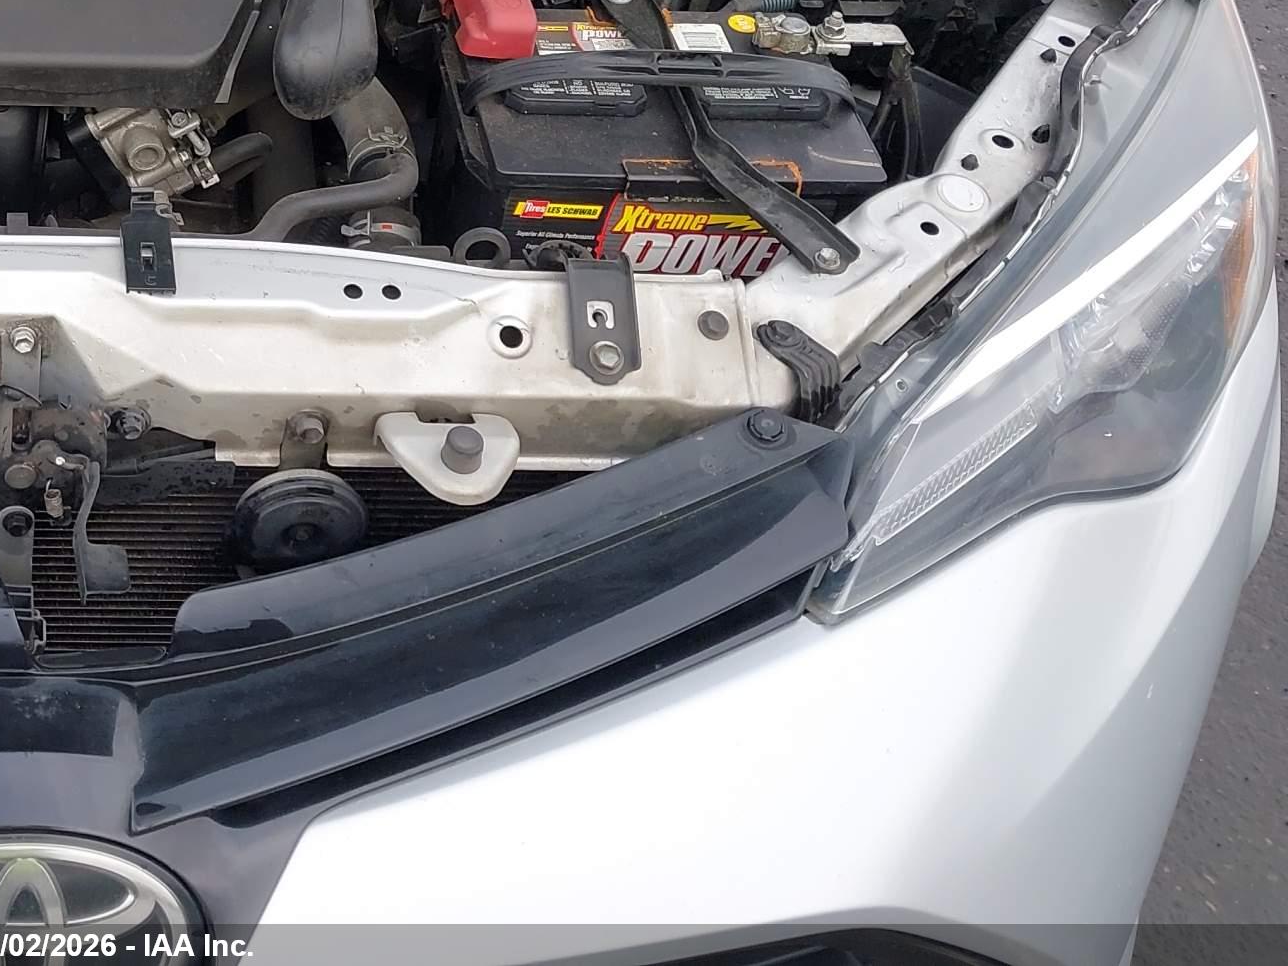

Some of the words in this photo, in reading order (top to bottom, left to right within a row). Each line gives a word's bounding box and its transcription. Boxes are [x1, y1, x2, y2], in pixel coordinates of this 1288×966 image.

[525, 201, 546, 213] Tires
[547, 206, 561, 214] LES
[562, 207, 598, 216] SCHWAB
[613, 205, 709, 233] Xtreme
[621, 232, 788, 277] POWE
